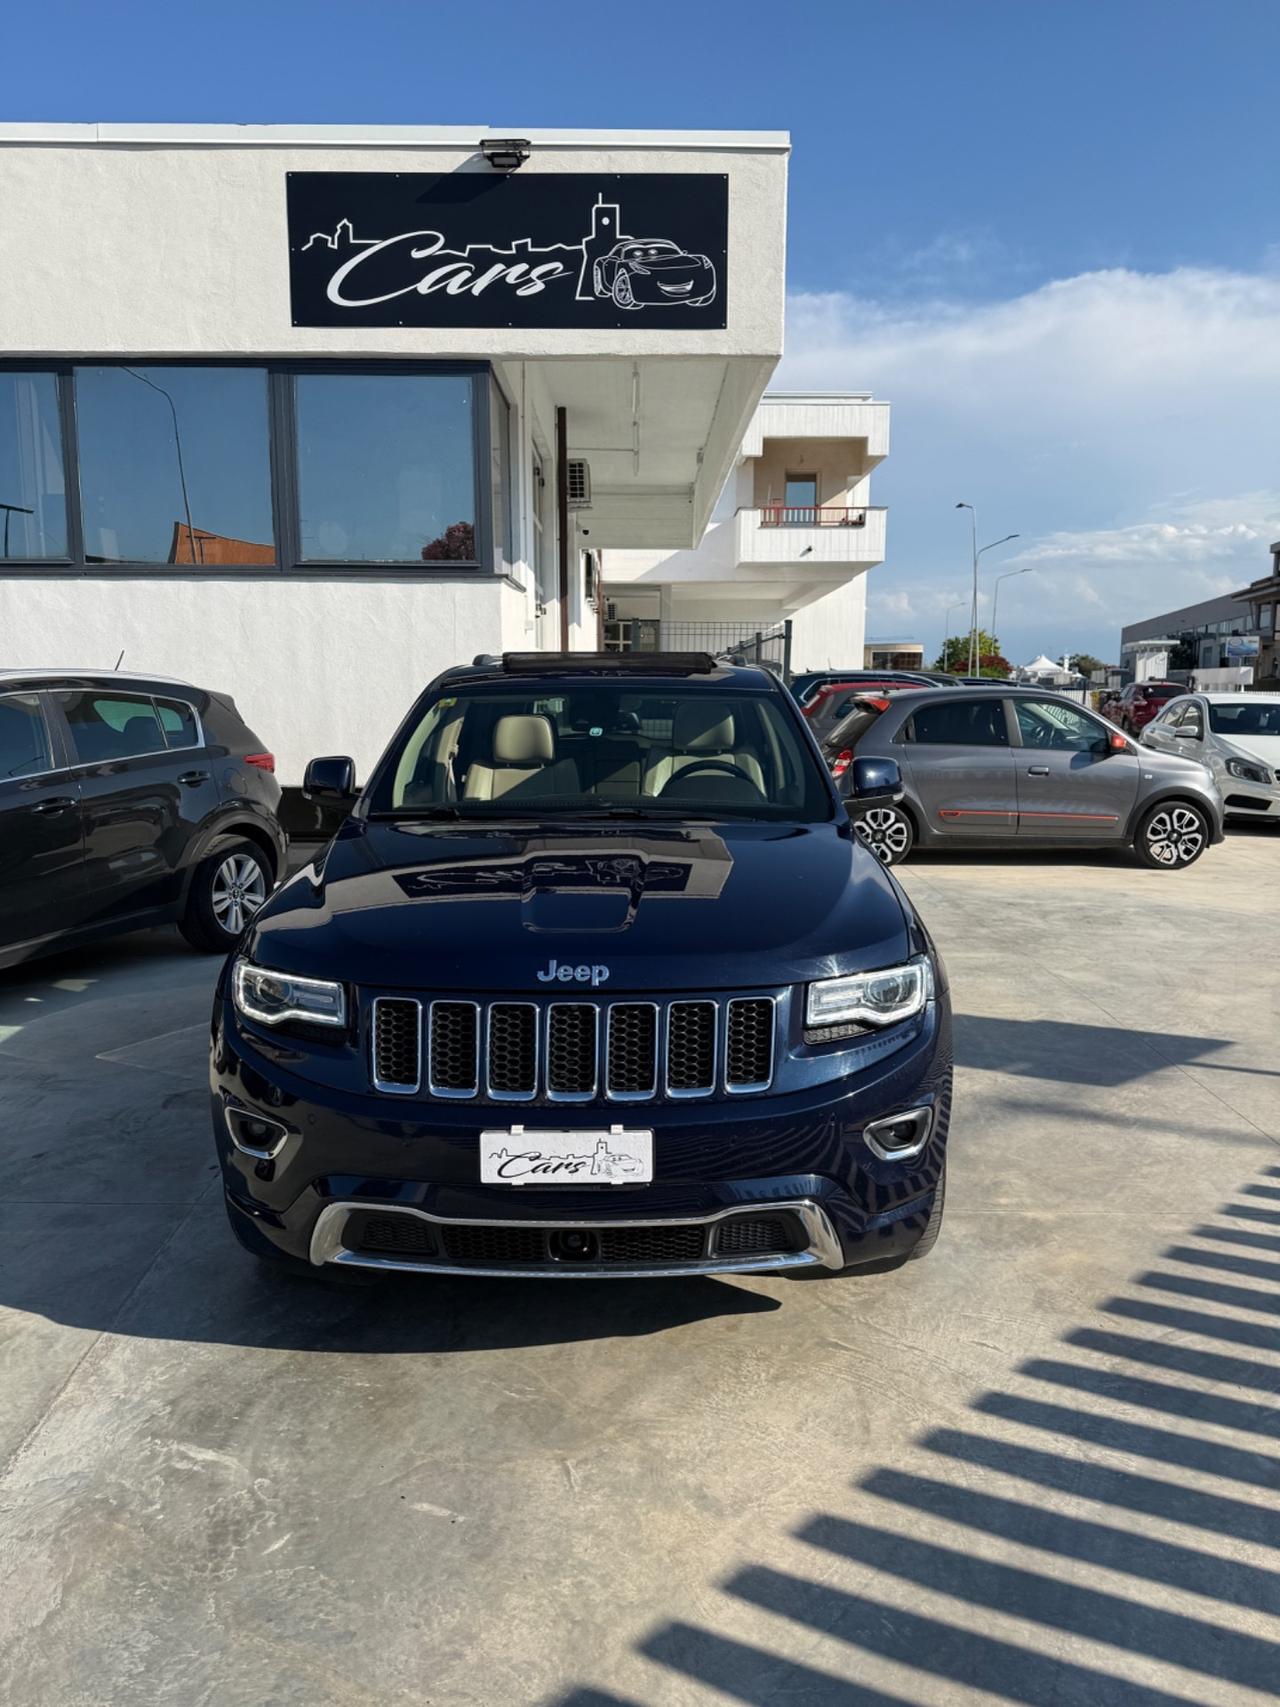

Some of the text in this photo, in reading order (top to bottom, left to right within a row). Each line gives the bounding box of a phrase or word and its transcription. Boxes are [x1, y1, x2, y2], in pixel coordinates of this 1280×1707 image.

[326, 230, 574, 307] Cars
[536, 959, 610, 986] Jeep
[497, 1151, 589, 1179] Cars
